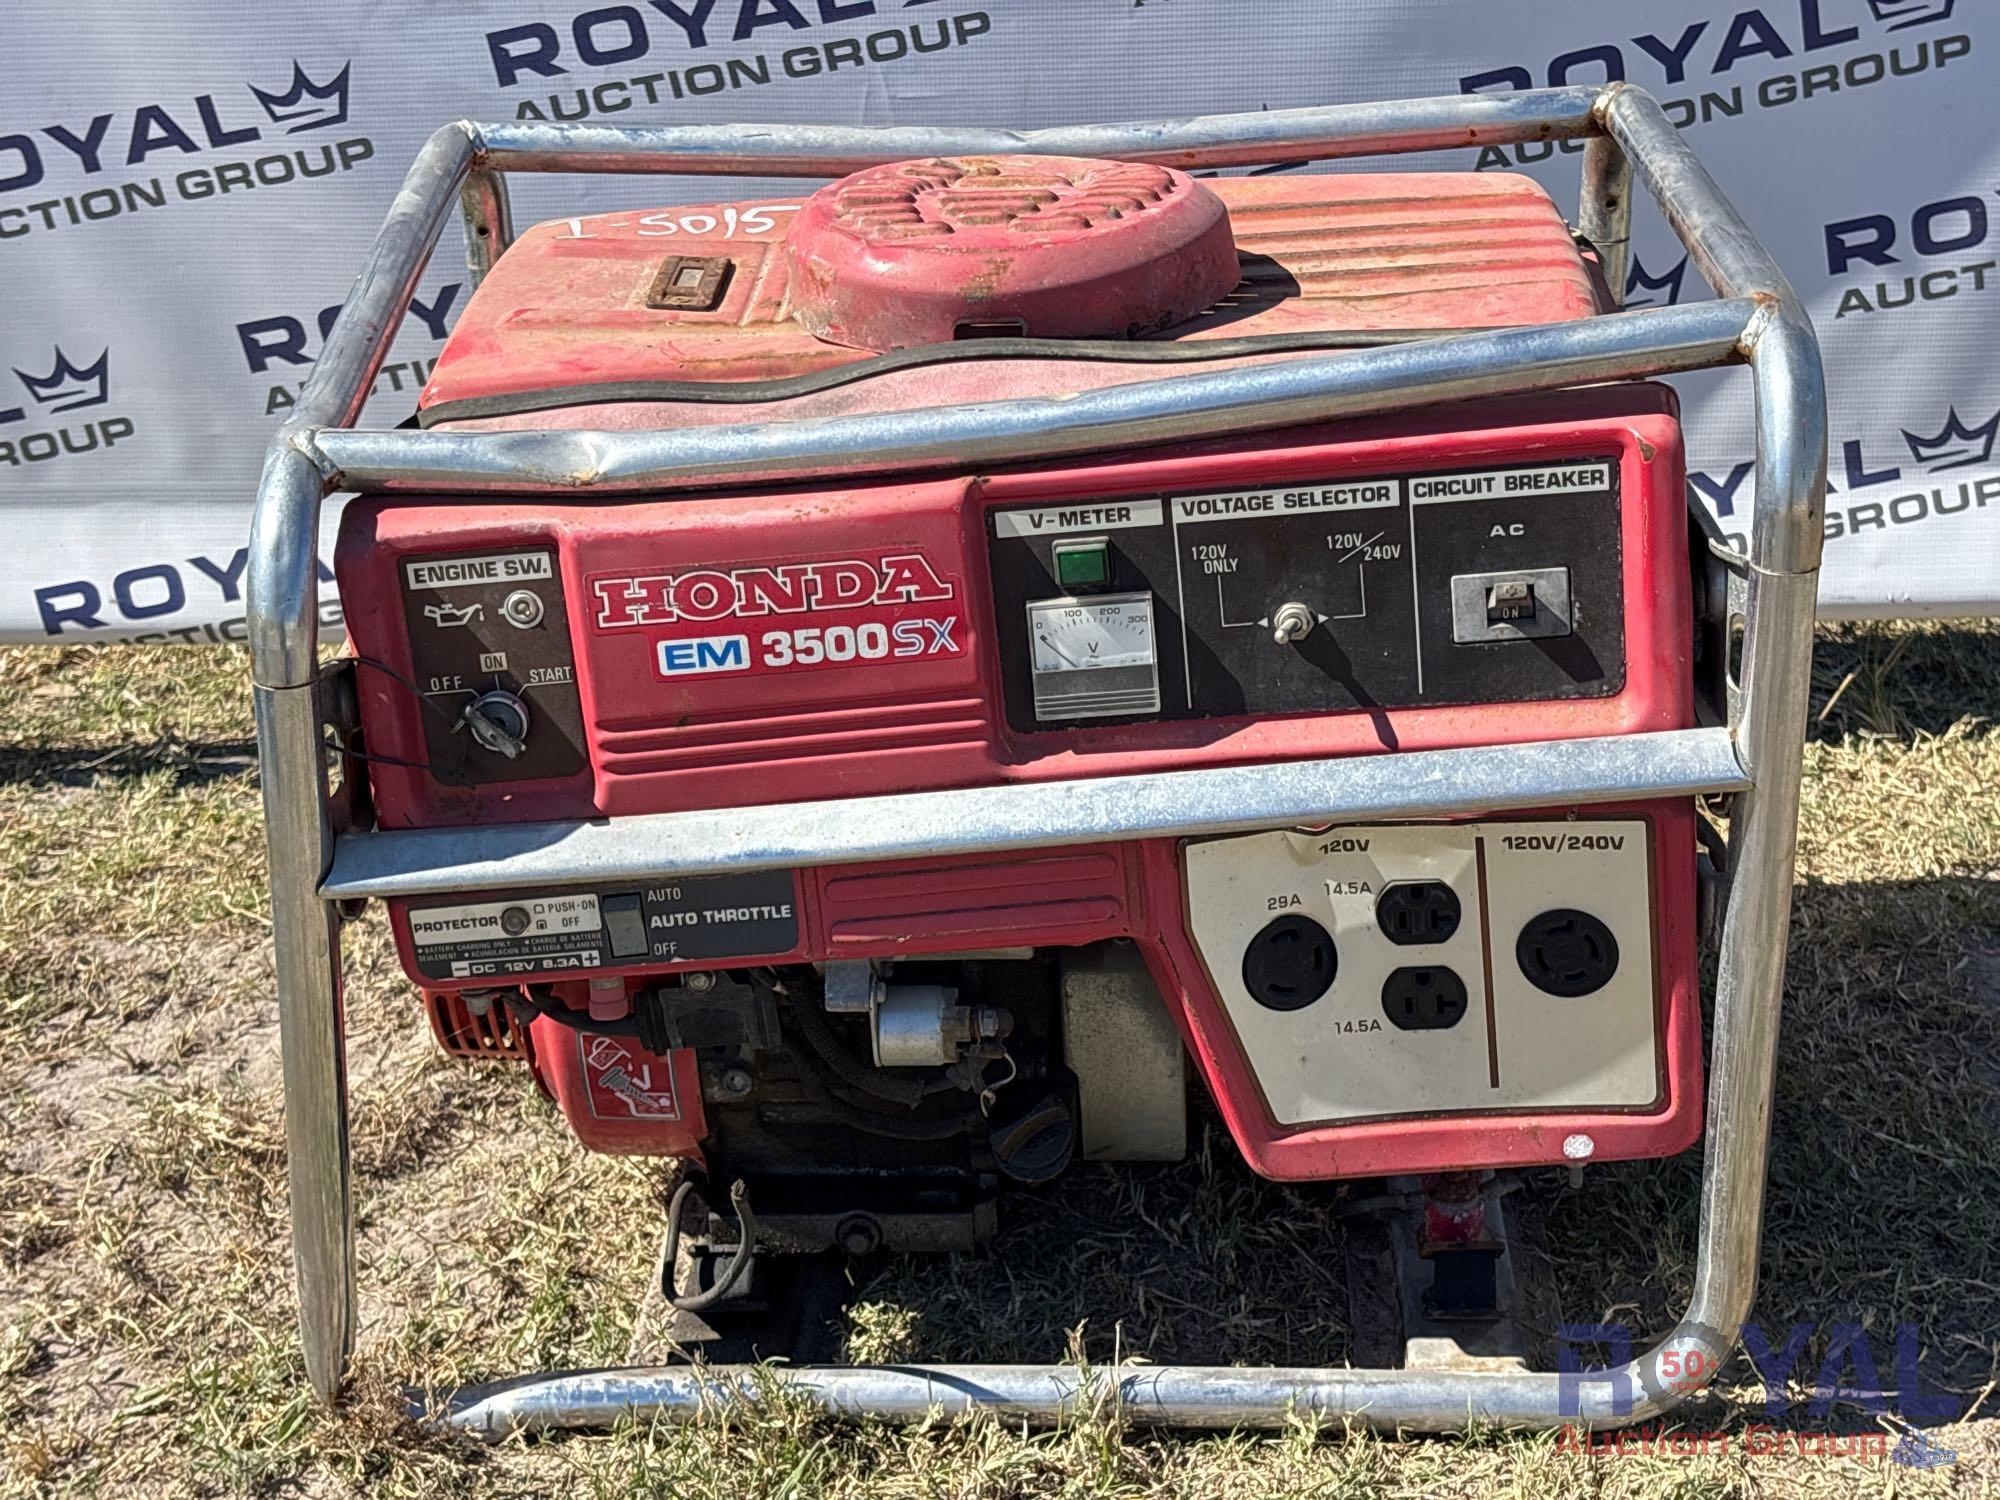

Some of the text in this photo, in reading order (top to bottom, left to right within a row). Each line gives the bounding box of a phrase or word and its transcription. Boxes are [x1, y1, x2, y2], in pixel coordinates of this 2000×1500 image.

[515, 11, 991, 120] AUCTION GROUP
[1757, 35, 1971, 109] GROUP
[176, 137, 374, 200] GROUP
[1413, 469, 1605, 498] CIRCUIT BREAKER
[1181, 486, 1391, 517] VOLTAGE SELECTOR
[1191, 544, 1227, 560] 120V
[1363, 544, 1401, 561] 240V
[413, 557, 548, 585] ENGINE SW.
[1203, 558, 1238, 575] ONLY
[594, 553, 954, 629] HONDA
[1035, 606, 1148, 630] 0 100 200 300
[1502, 606, 1519, 619] ON
[663, 639, 744, 671] EM
[1087, 641, 1099, 654] V
[484, 655, 504, 670] ON
[430, 675, 463, 692] OFF
[529, 665, 572, 684] START
[1318, 838, 1371, 855] 120V
[1502, 833, 1625, 853] 120V/240V
[648, 887, 681, 903] AUTO
[1323, 881, 1372, 896] 14.5A
[1267, 893, 1302, 911] 29A
[413, 916, 499, 934] PROTECTOR
[562, 917, 581, 928] OFF
[650, 904, 792, 929] AUTO THROTTLE
[653, 941, 678, 956] OFF
[472, 956, 581, 974] DC 12V 8.3A
[1334, 1019, 1382, 1035] 14.5A
